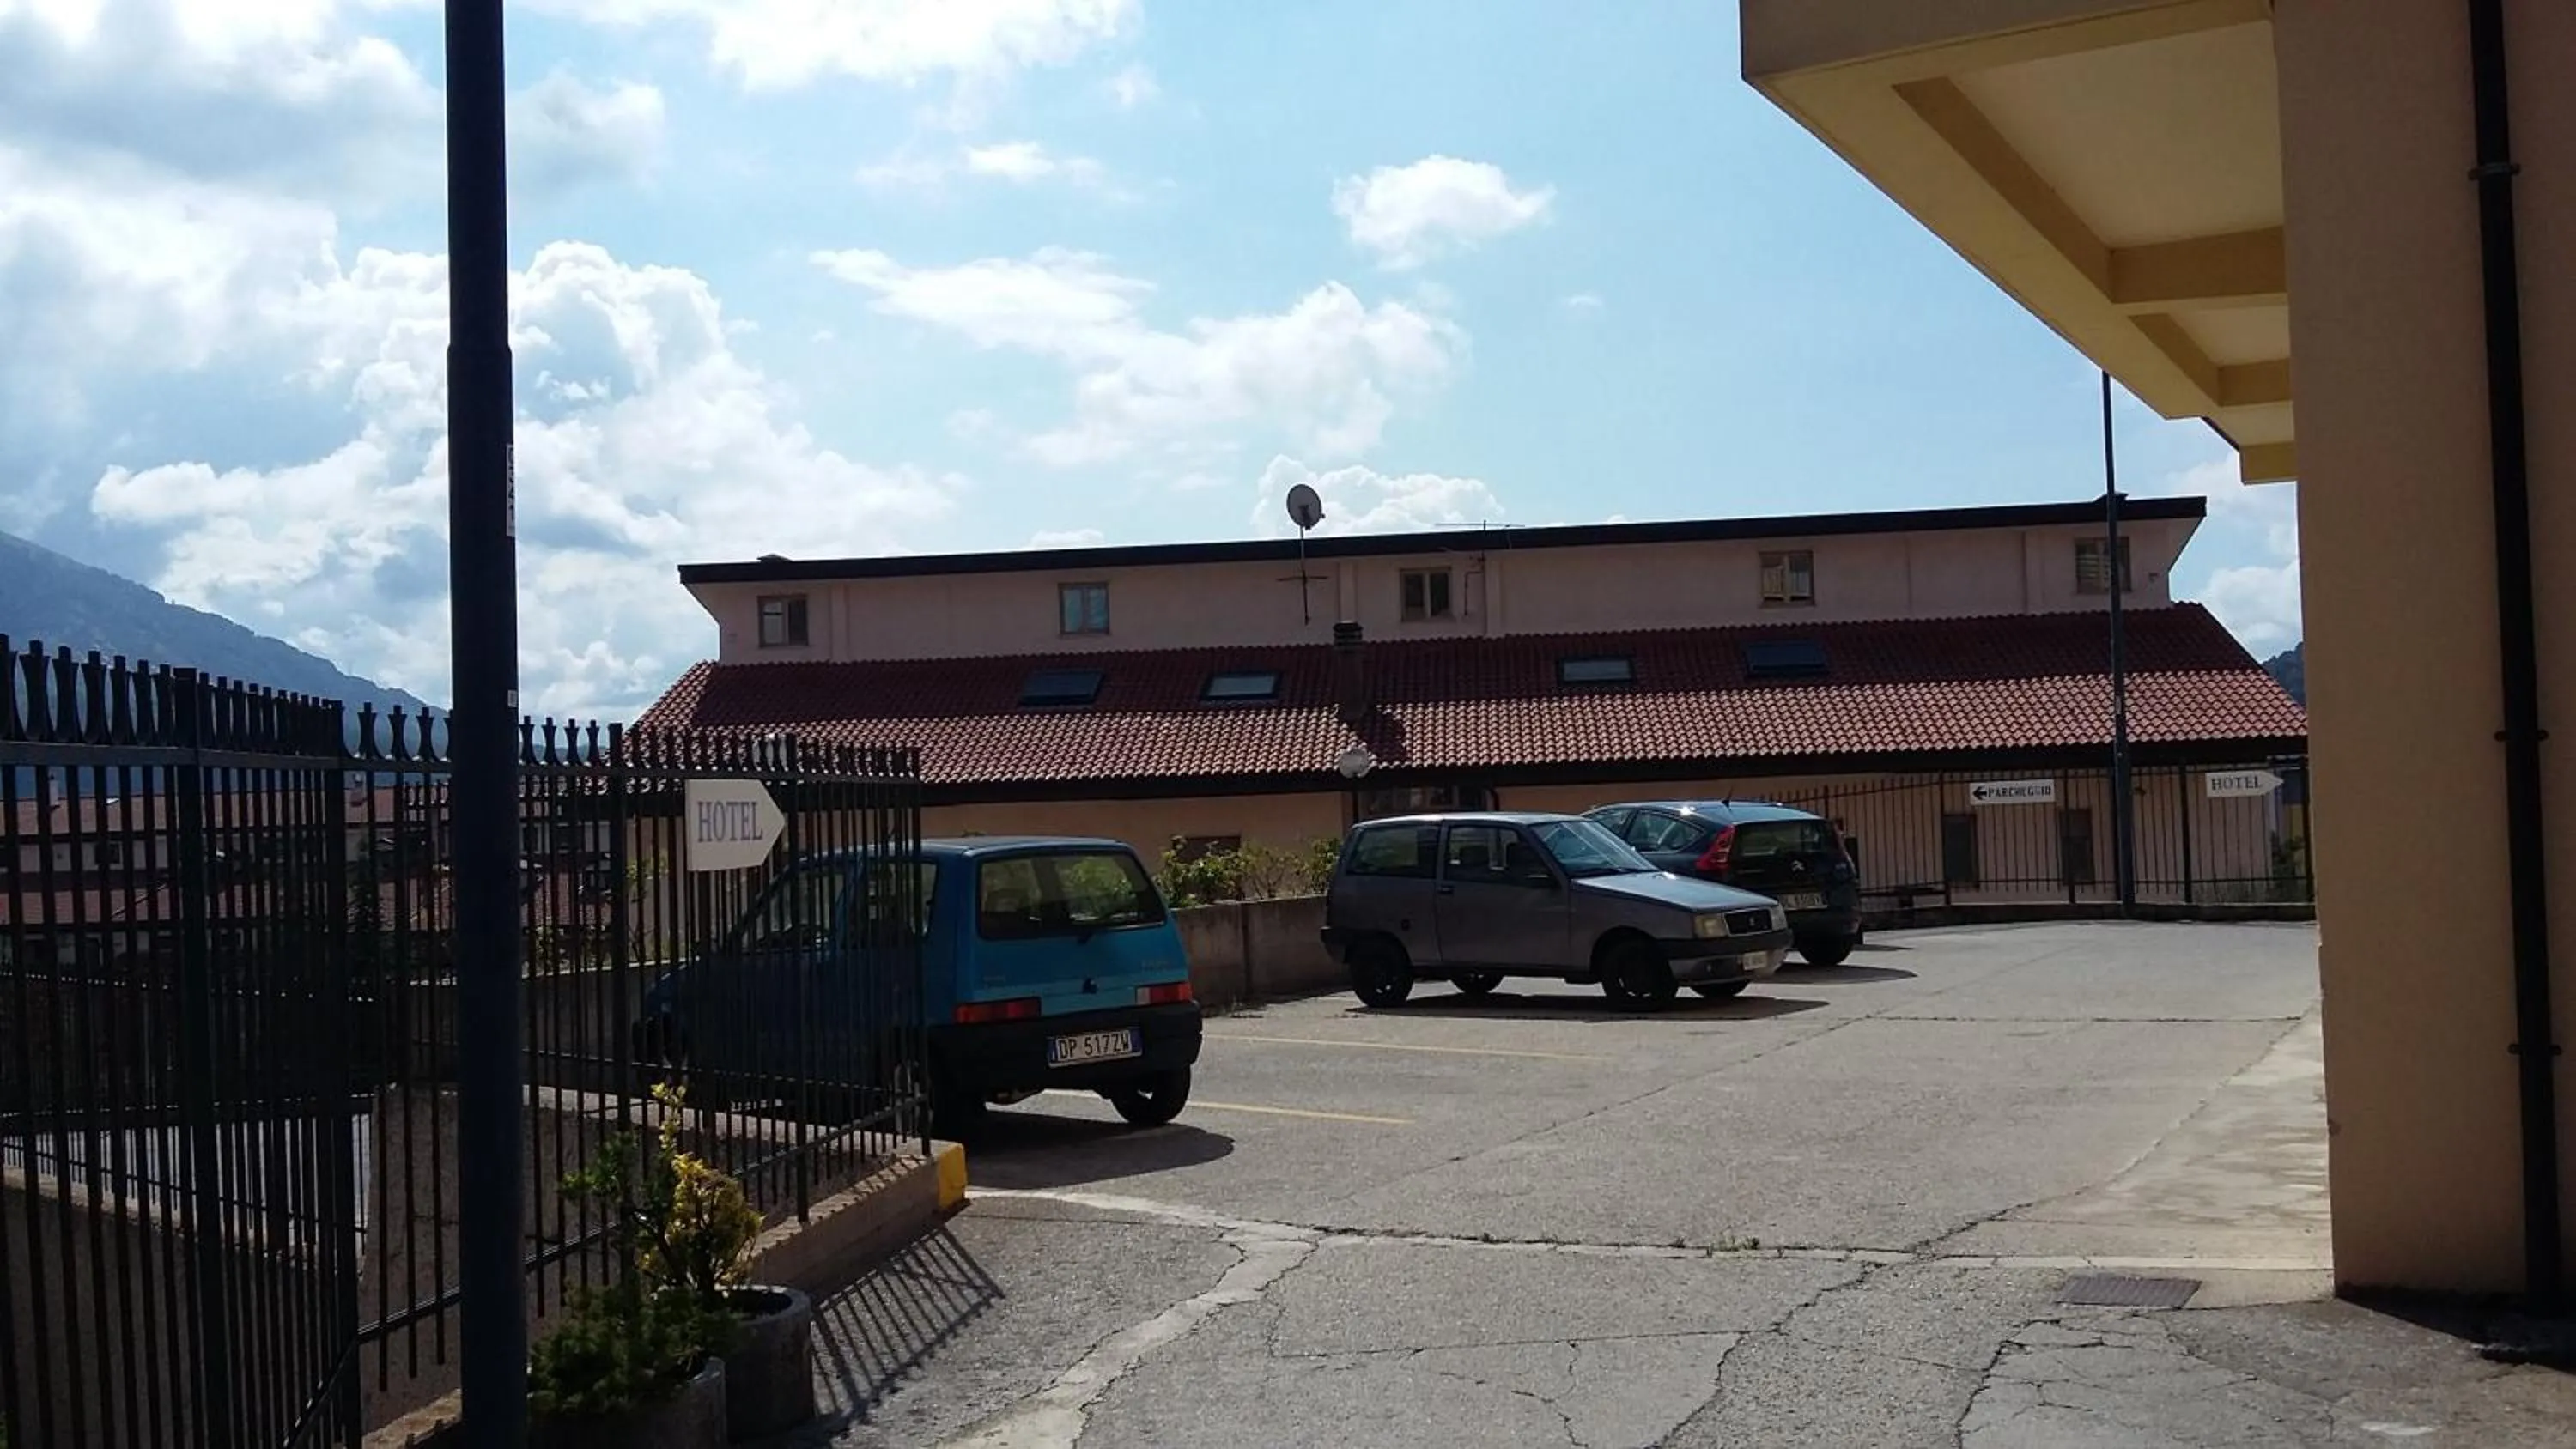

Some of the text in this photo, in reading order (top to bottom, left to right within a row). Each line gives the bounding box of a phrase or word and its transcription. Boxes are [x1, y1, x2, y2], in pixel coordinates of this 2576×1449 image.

[2211, 776, 2260, 790] HOTEL
[697, 800, 763, 842] HOTEL
[1059, 1038, 1077, 1058] DP
